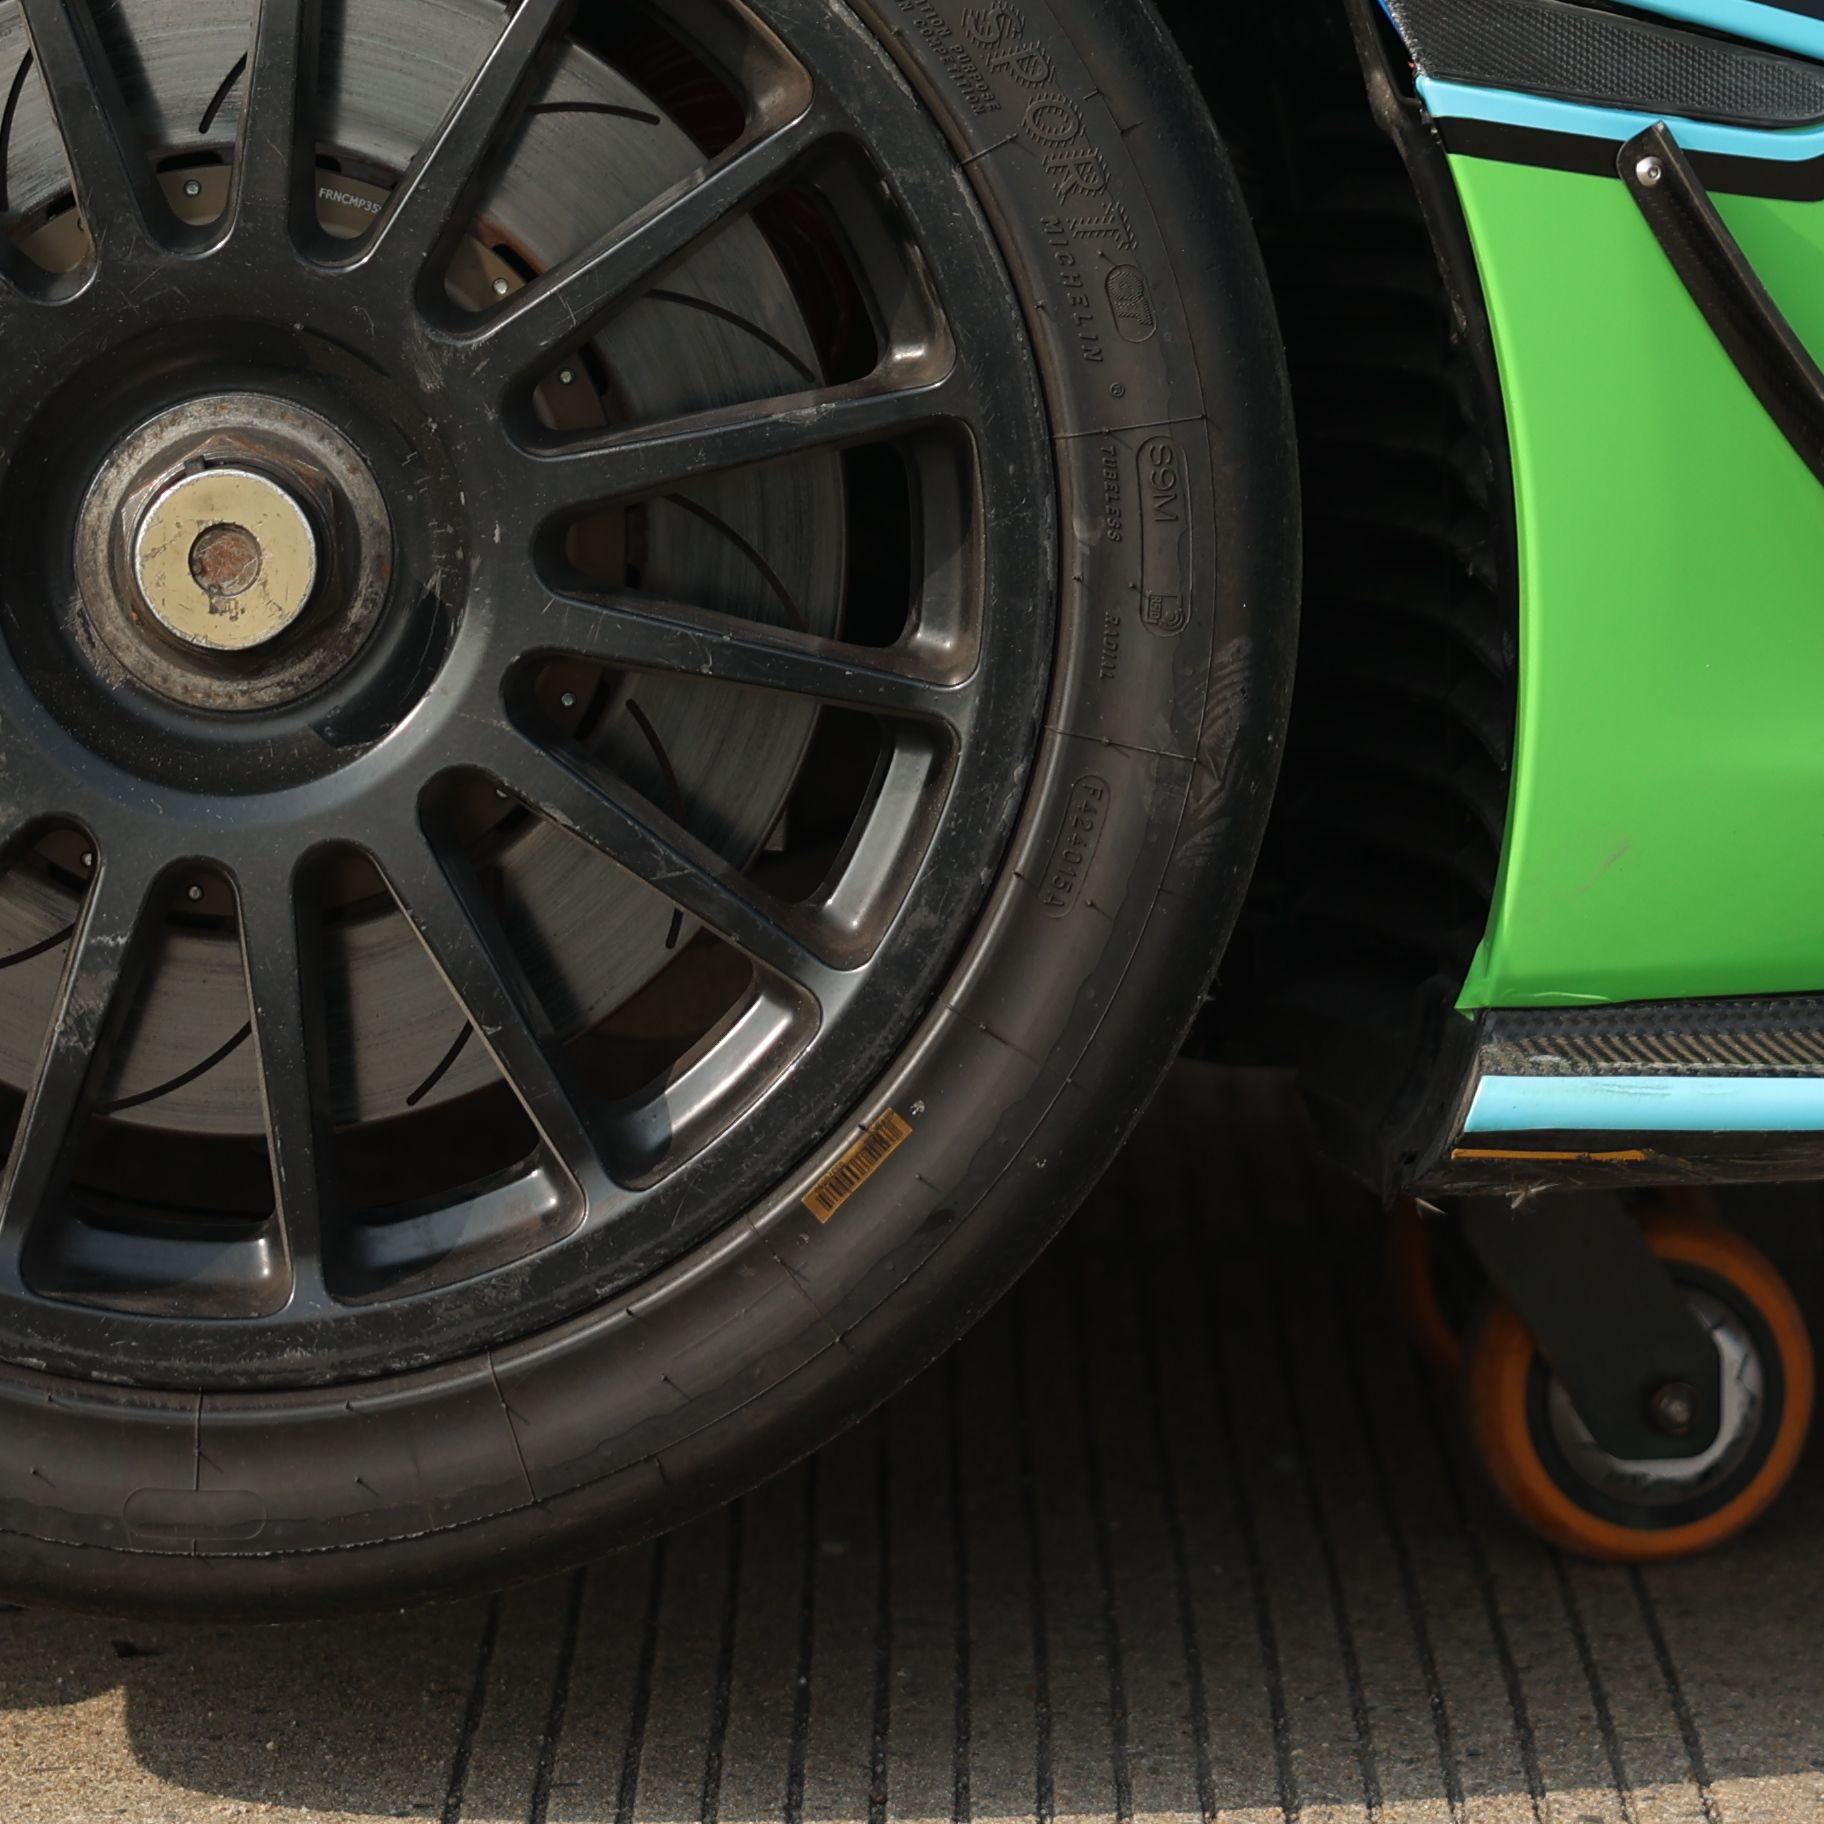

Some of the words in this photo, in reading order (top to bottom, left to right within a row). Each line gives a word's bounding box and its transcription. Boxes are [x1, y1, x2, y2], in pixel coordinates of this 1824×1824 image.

[912, 18, 987, 115] COMPETITION
[950, 43, 1002, 113] PURPOSE
[961, 1, 1138, 252] SPORT
[319, 187, 382, 215] FRNCMP35
[1040, 215, 1103, 364] MICHELIN
[1100, 445, 1122, 543] TUBELESS
[1148, 443, 1179, 524] S9M
[1098, 612, 1121, 680] RADIAL
